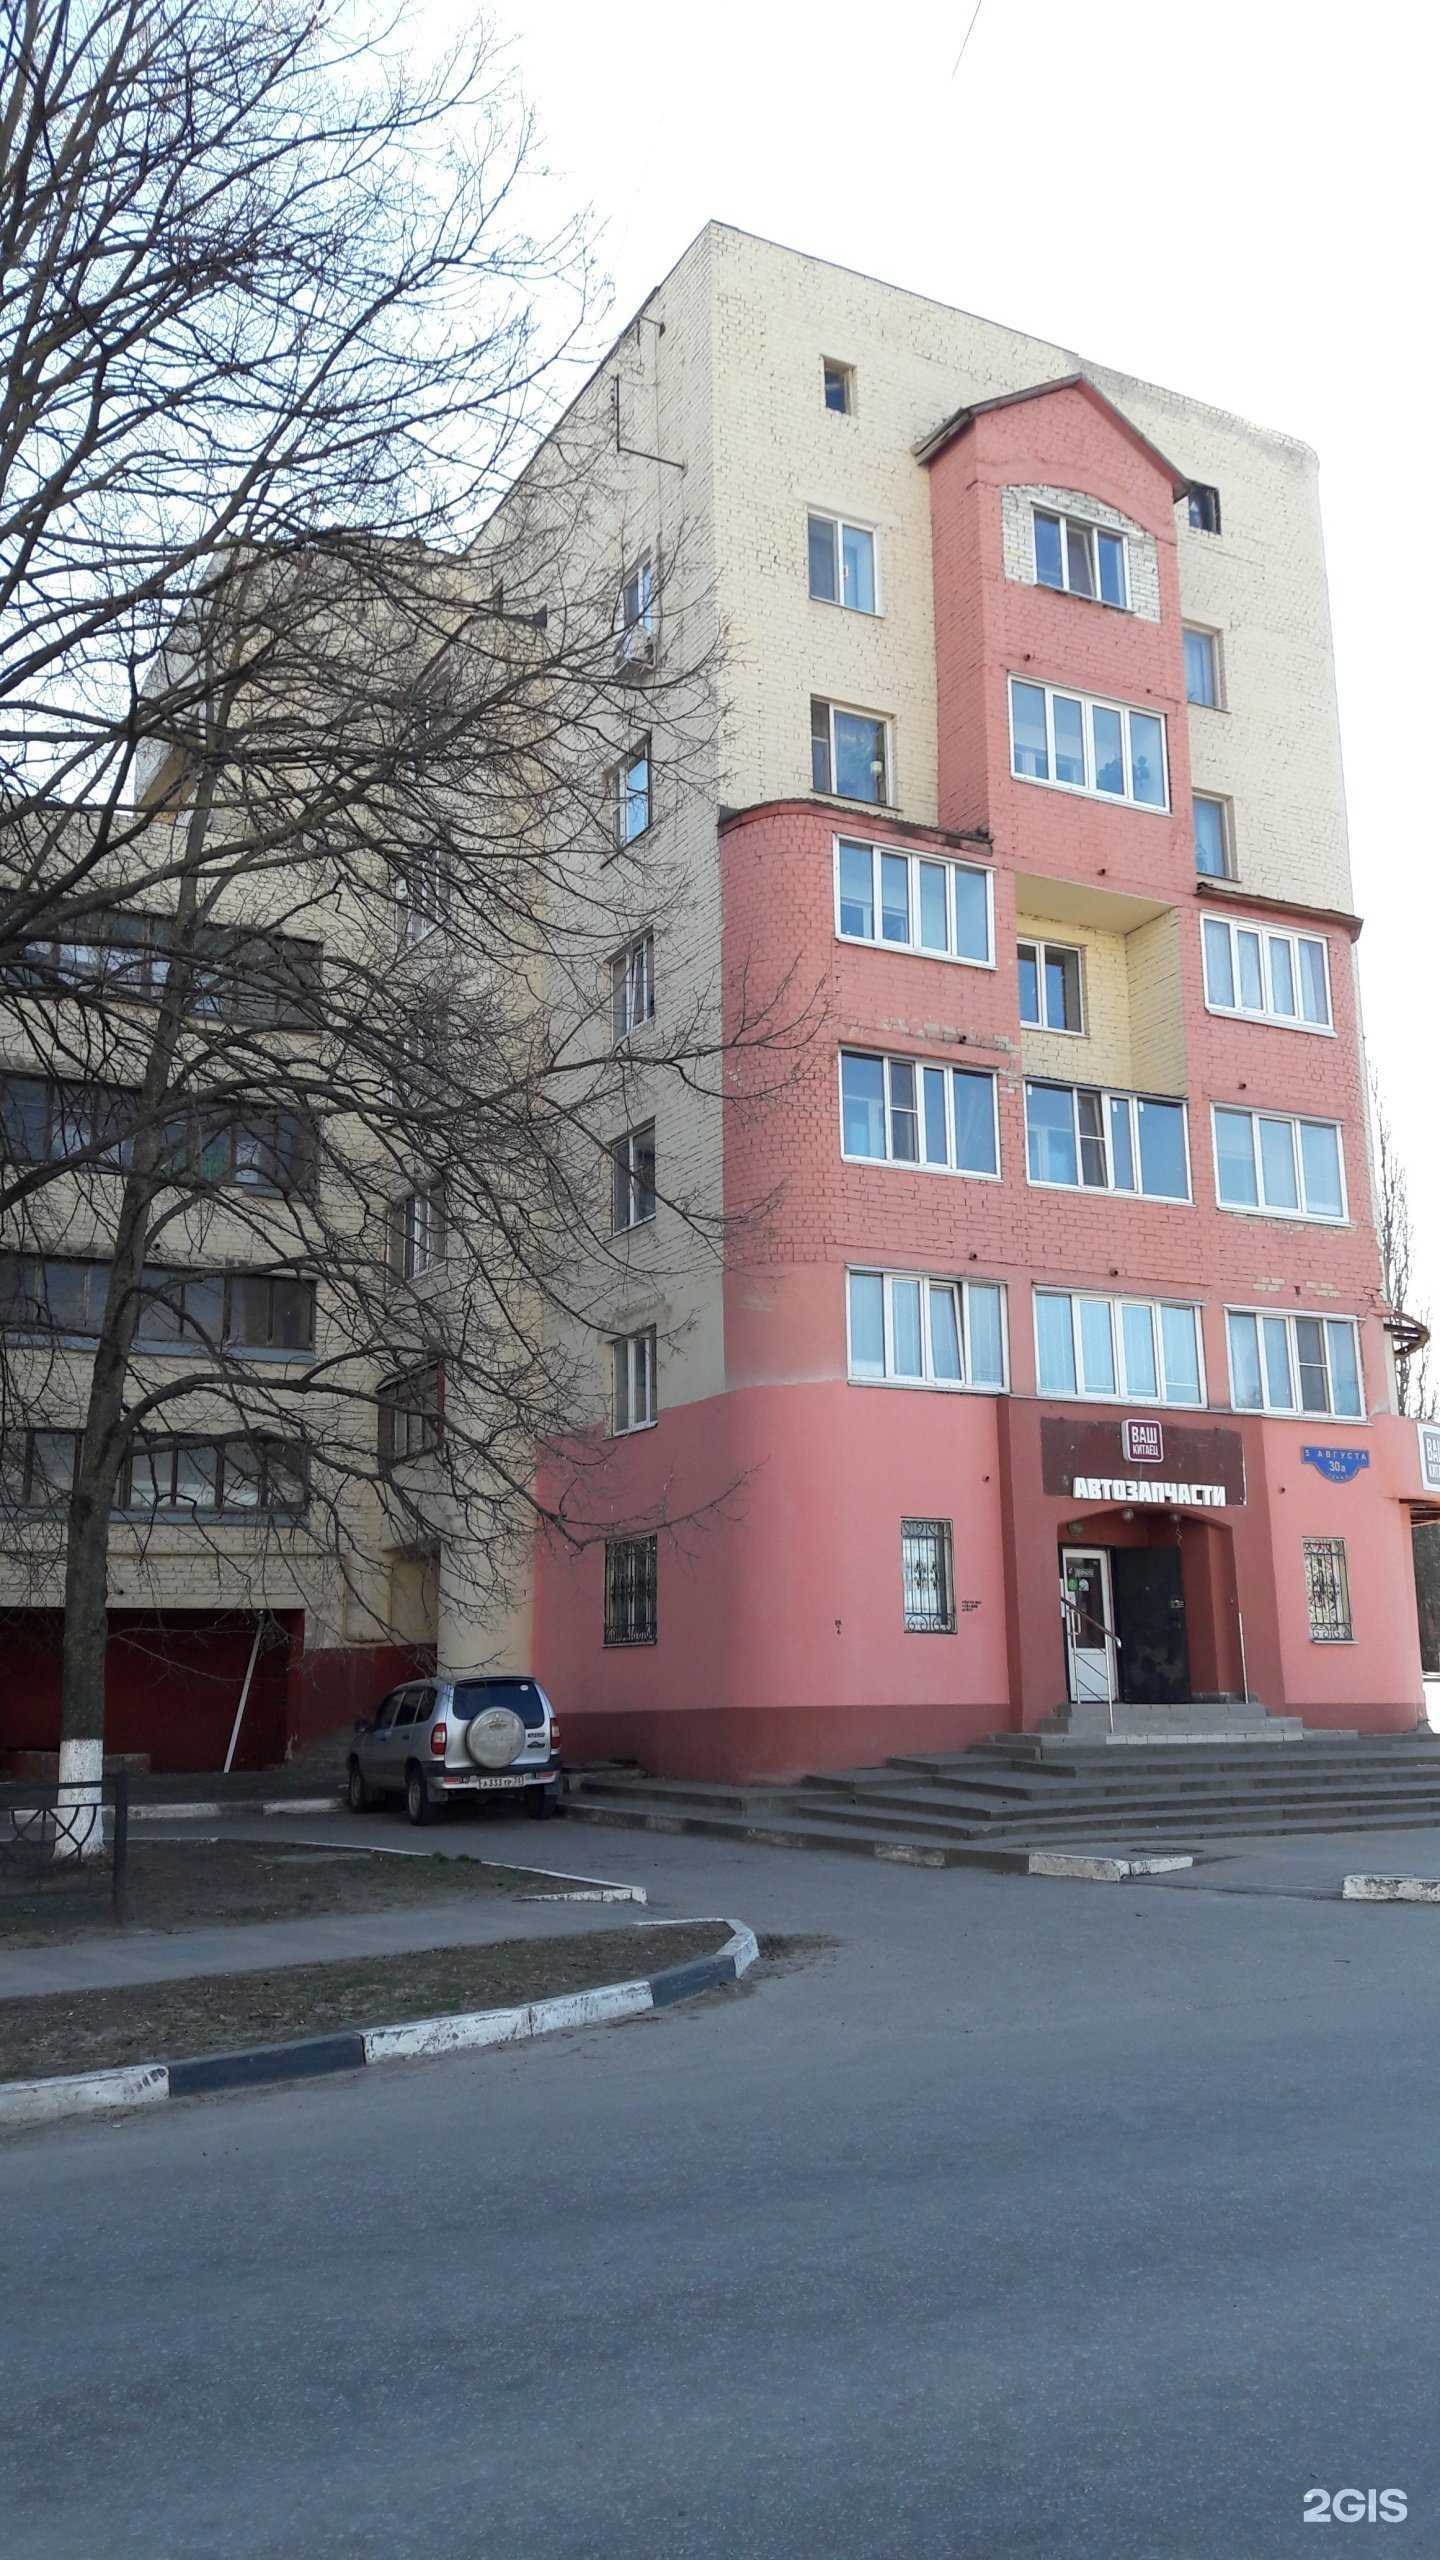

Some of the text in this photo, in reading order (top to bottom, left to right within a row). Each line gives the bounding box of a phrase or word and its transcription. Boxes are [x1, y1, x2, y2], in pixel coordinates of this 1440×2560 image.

[1131, 1426, 1157, 1444] ВАШ
[1132, 1444, 1160, 1457] КИТАЕЦ
[1317, 1450, 1368, 1461] АВГУСТА
[1073, 1477, 1226, 1507] АВТОЗАПЧАСТИ
